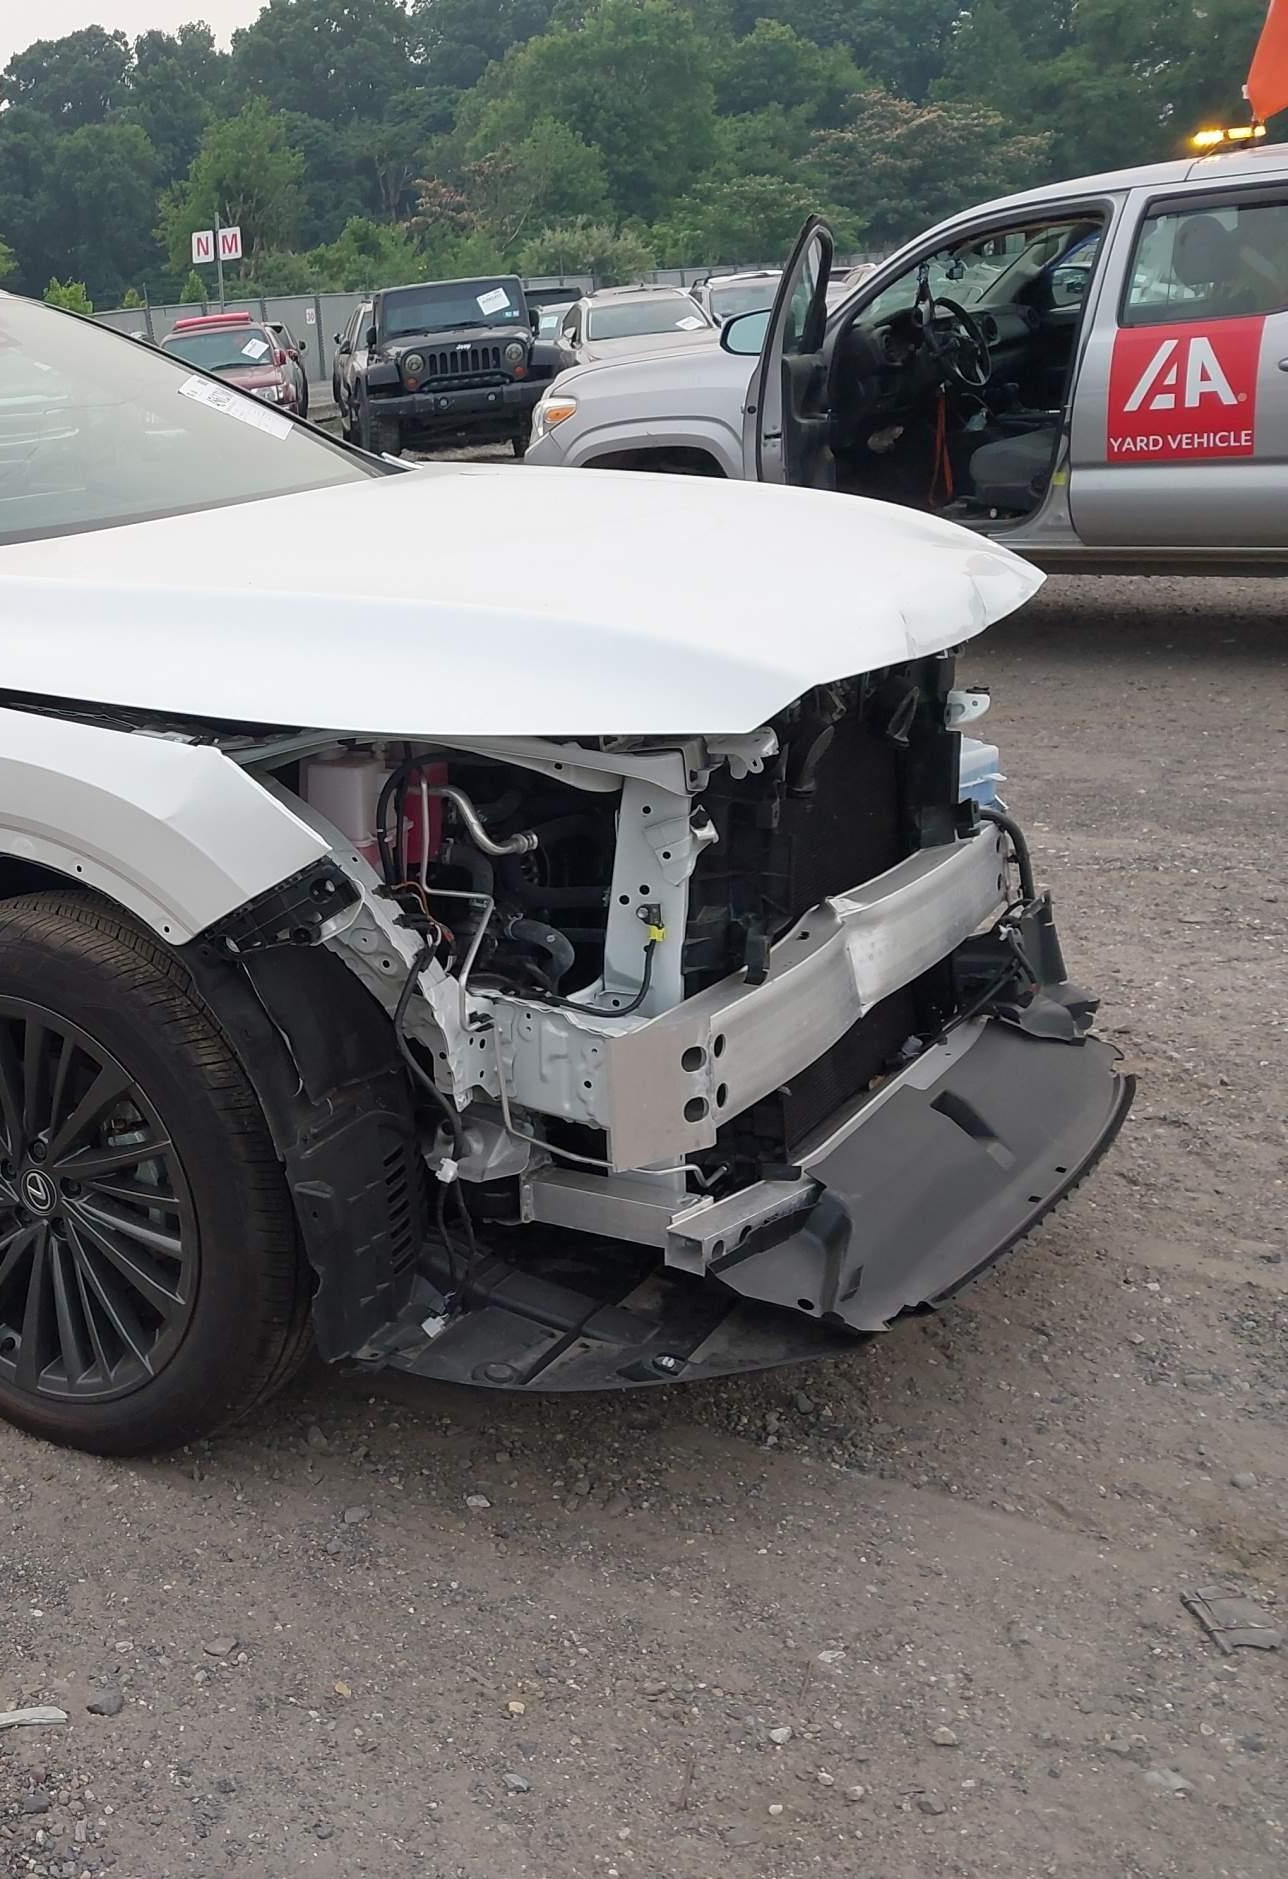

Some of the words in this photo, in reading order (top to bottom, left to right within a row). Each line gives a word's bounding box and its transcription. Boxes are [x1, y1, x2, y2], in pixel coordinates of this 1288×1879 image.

[196, 235, 209, 257] N
[221, 233, 238, 255] M
[1109, 435, 1163, 452] YARD
[1167, 430, 1253, 450] VEHICLE
